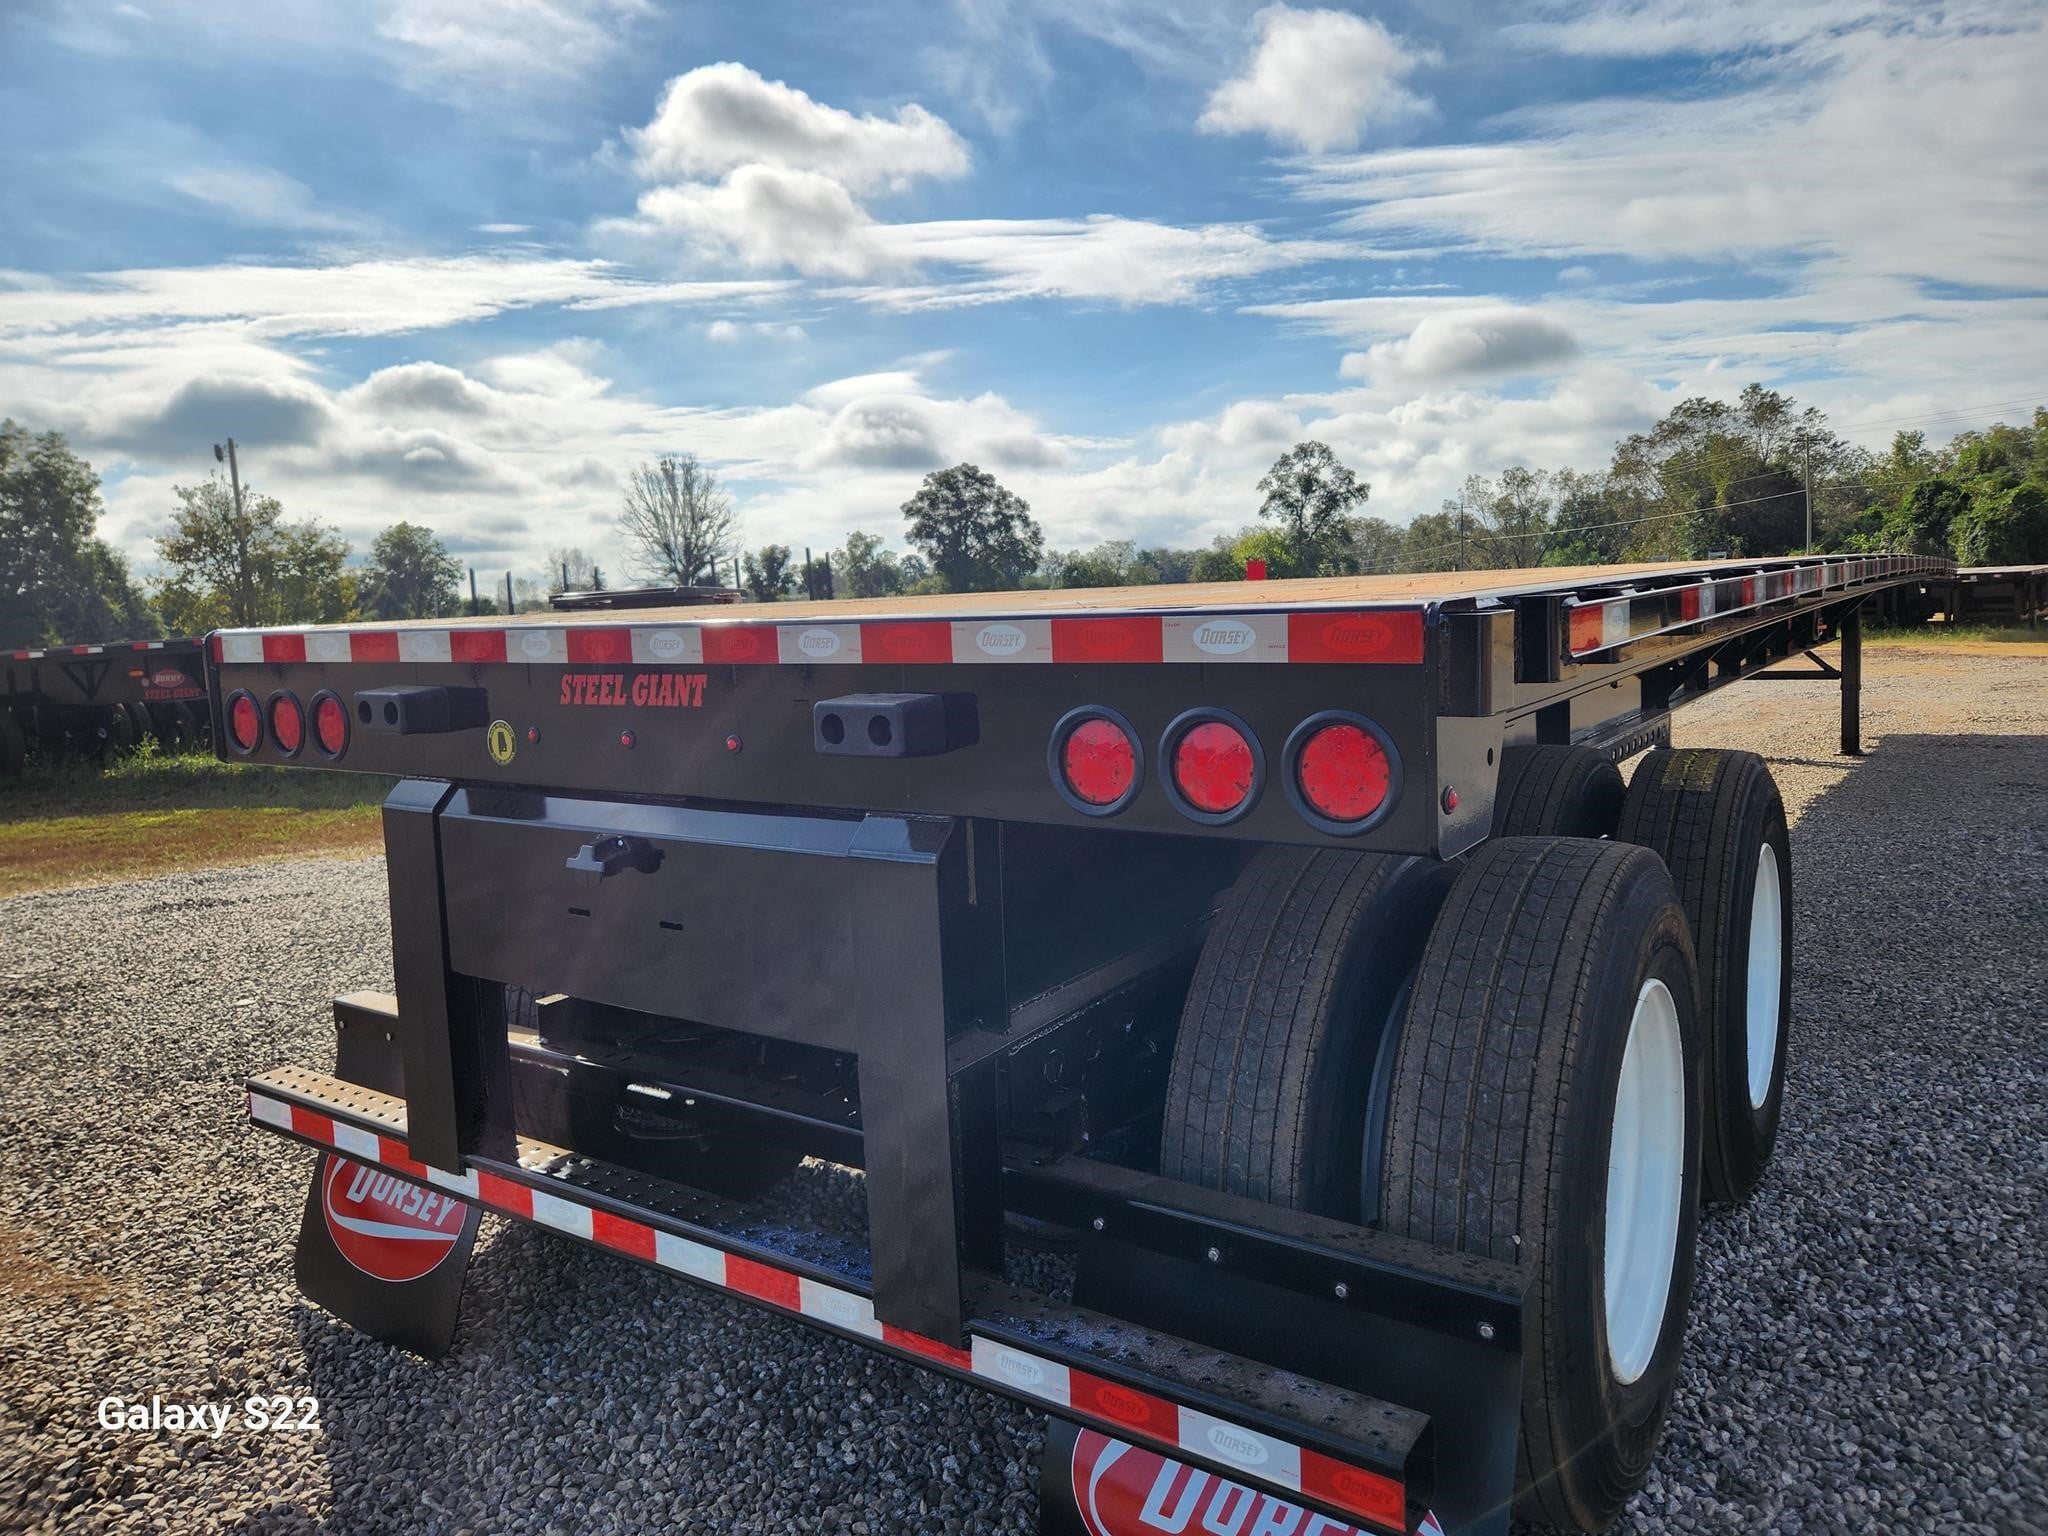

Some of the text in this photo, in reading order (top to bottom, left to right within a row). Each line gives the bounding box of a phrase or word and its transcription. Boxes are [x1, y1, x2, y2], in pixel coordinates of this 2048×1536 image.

[653, 637, 681, 650] DORSEY
[803, 635, 835, 649] DORSEY
[981, 631, 1021, 647] DORSEY
[1200, 628, 1249, 645] DORSEY
[1331, 627, 1385, 643] DORSEY
[560, 674, 707, 707] STEEL GIANT
[1001, 1355, 1039, 1379] DORSEY
[1102, 1390, 1144, 1415] DORSEY
[1214, 1430, 1262, 1459] DORSEY
